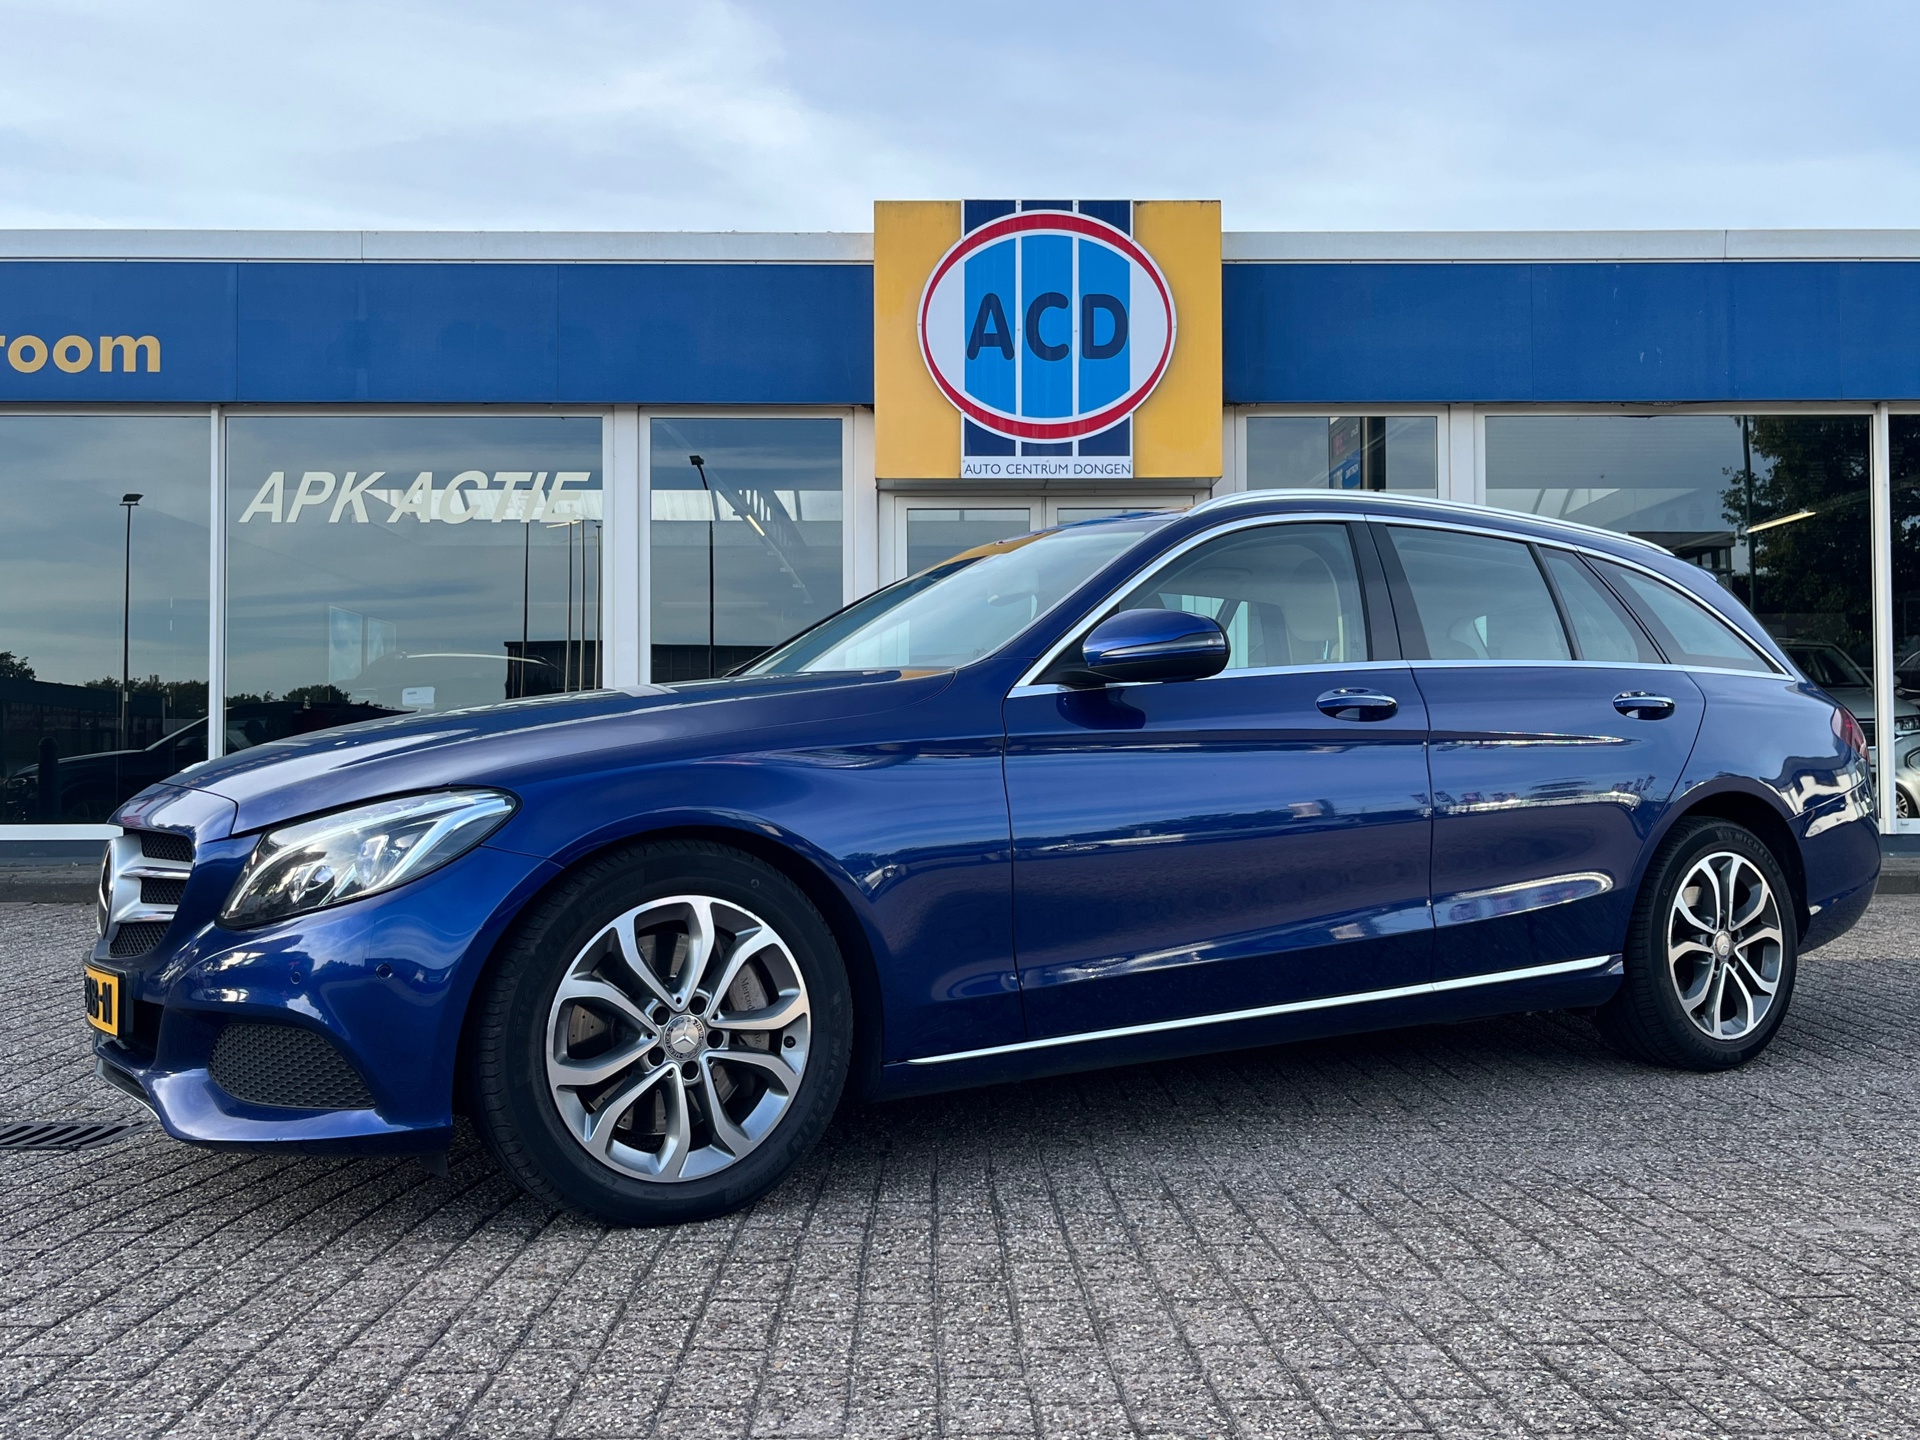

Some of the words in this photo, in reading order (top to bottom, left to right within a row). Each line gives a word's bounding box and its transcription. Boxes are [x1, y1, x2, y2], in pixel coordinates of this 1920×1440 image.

[966, 291, 1129, 361] ACD
[0, 335, 161, 373] oom
[964, 463, 1001, 475] AUTO
[1006, 463, 1069, 475] CENTRUM
[1073, 463, 1131, 475] DONGEN
[238, 471, 386, 523] APK
[386, 470, 591, 524] ACTIE
